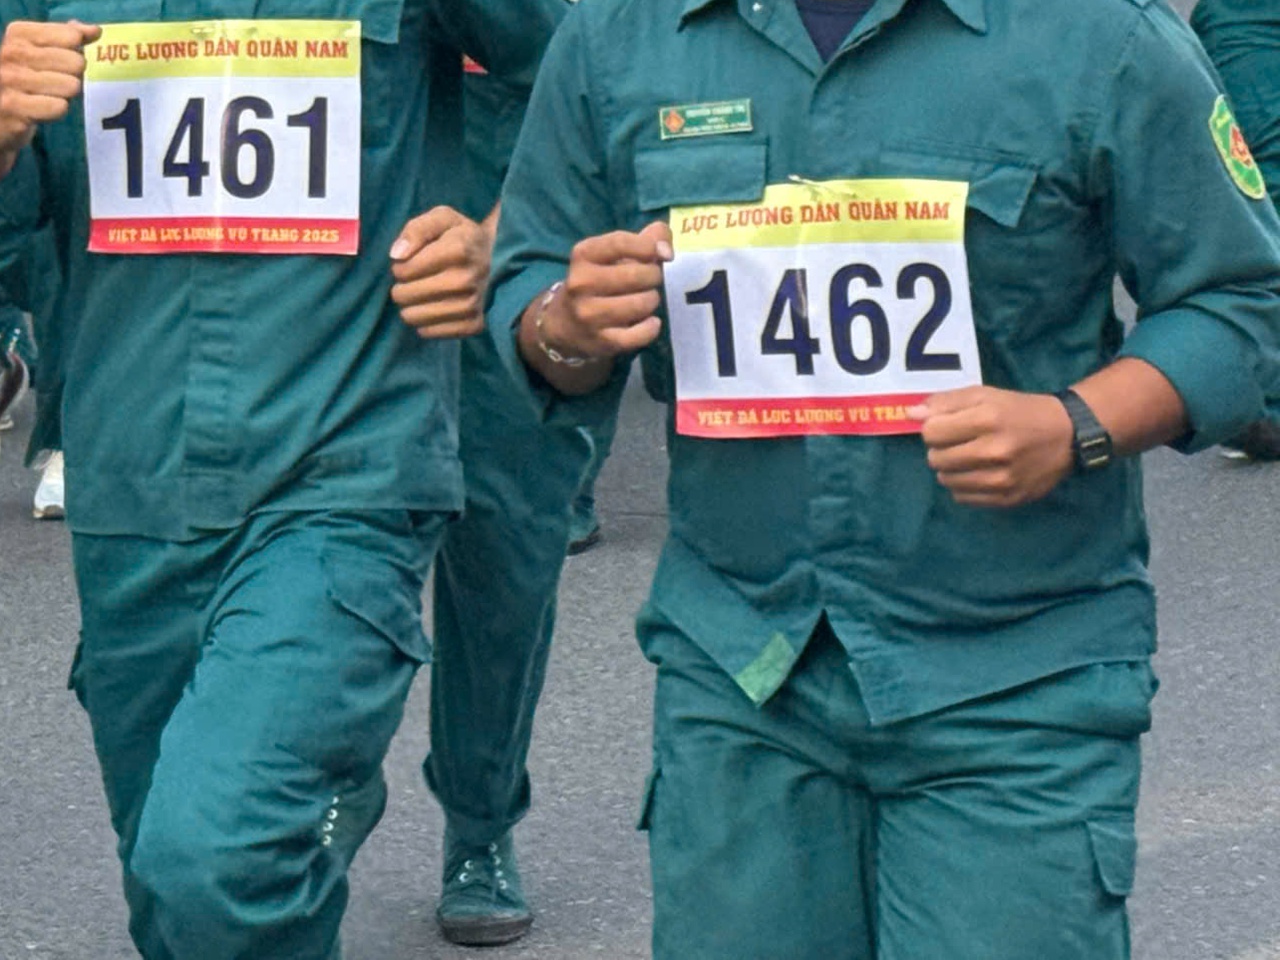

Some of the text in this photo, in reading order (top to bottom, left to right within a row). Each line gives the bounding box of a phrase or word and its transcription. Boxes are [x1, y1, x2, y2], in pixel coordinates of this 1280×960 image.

[305, 40, 349, 58] NAM
[101, 95, 328, 199] 1461
[905, 201, 950, 221] NAM
[251, 228, 299, 242] TRANG
[302, 229, 340, 243] 2025
[685, 262, 962, 378] 1462
